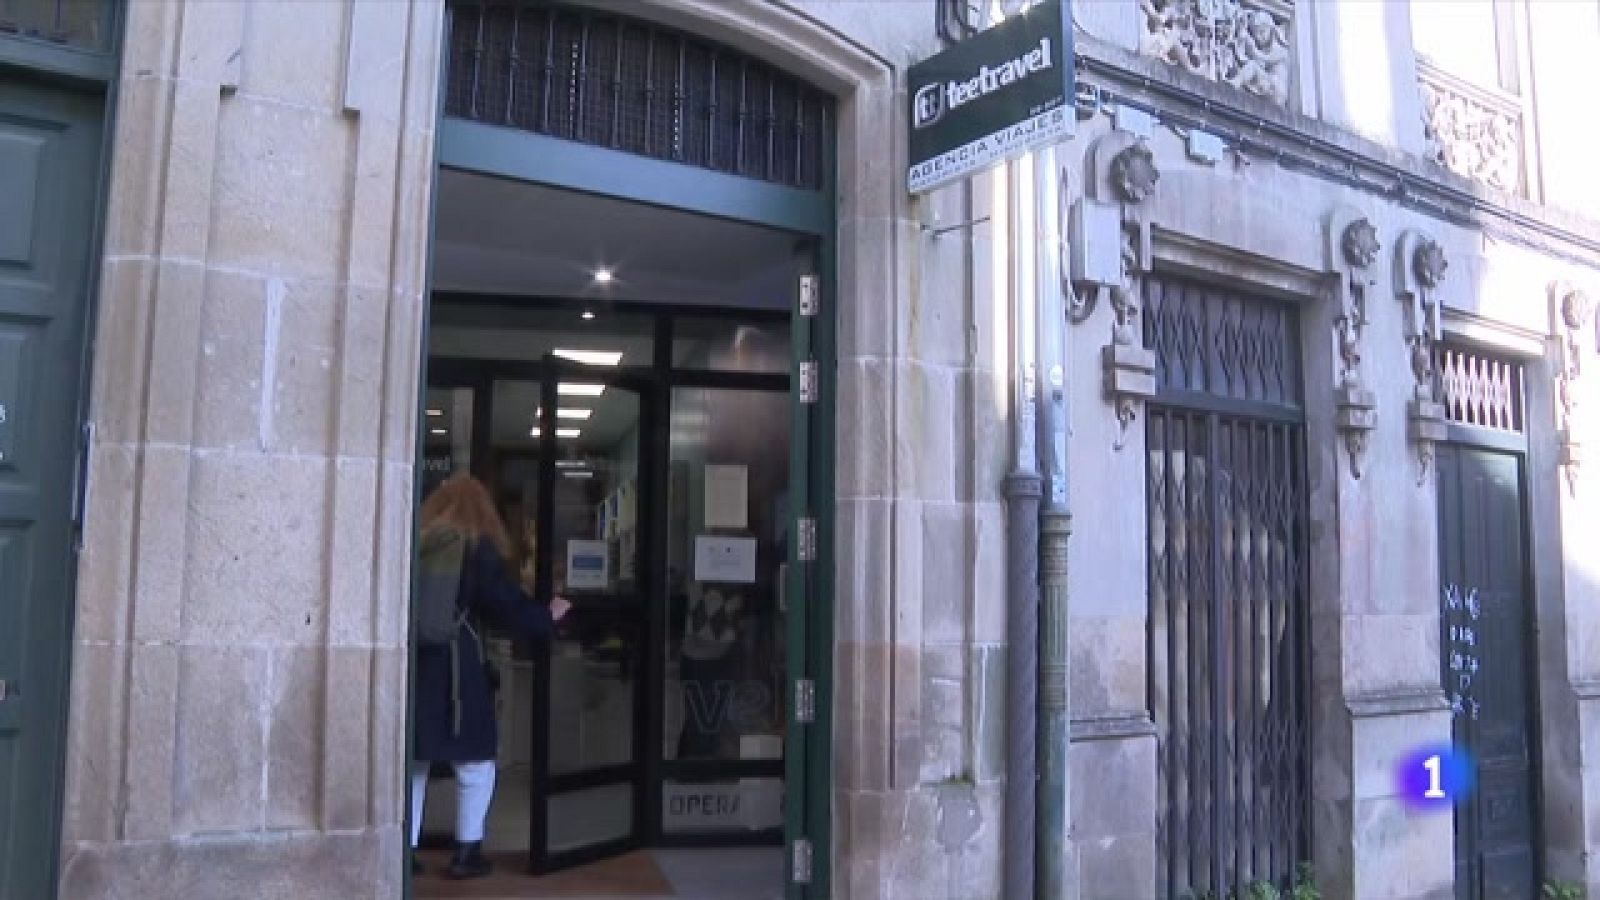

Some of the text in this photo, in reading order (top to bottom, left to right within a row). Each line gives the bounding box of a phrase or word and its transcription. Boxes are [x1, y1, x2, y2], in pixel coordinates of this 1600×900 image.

[947, 37, 1053, 109] teetravel
[912, 141, 988, 179] AGENCIA
[994, 108, 1064, 145] VIAJES
